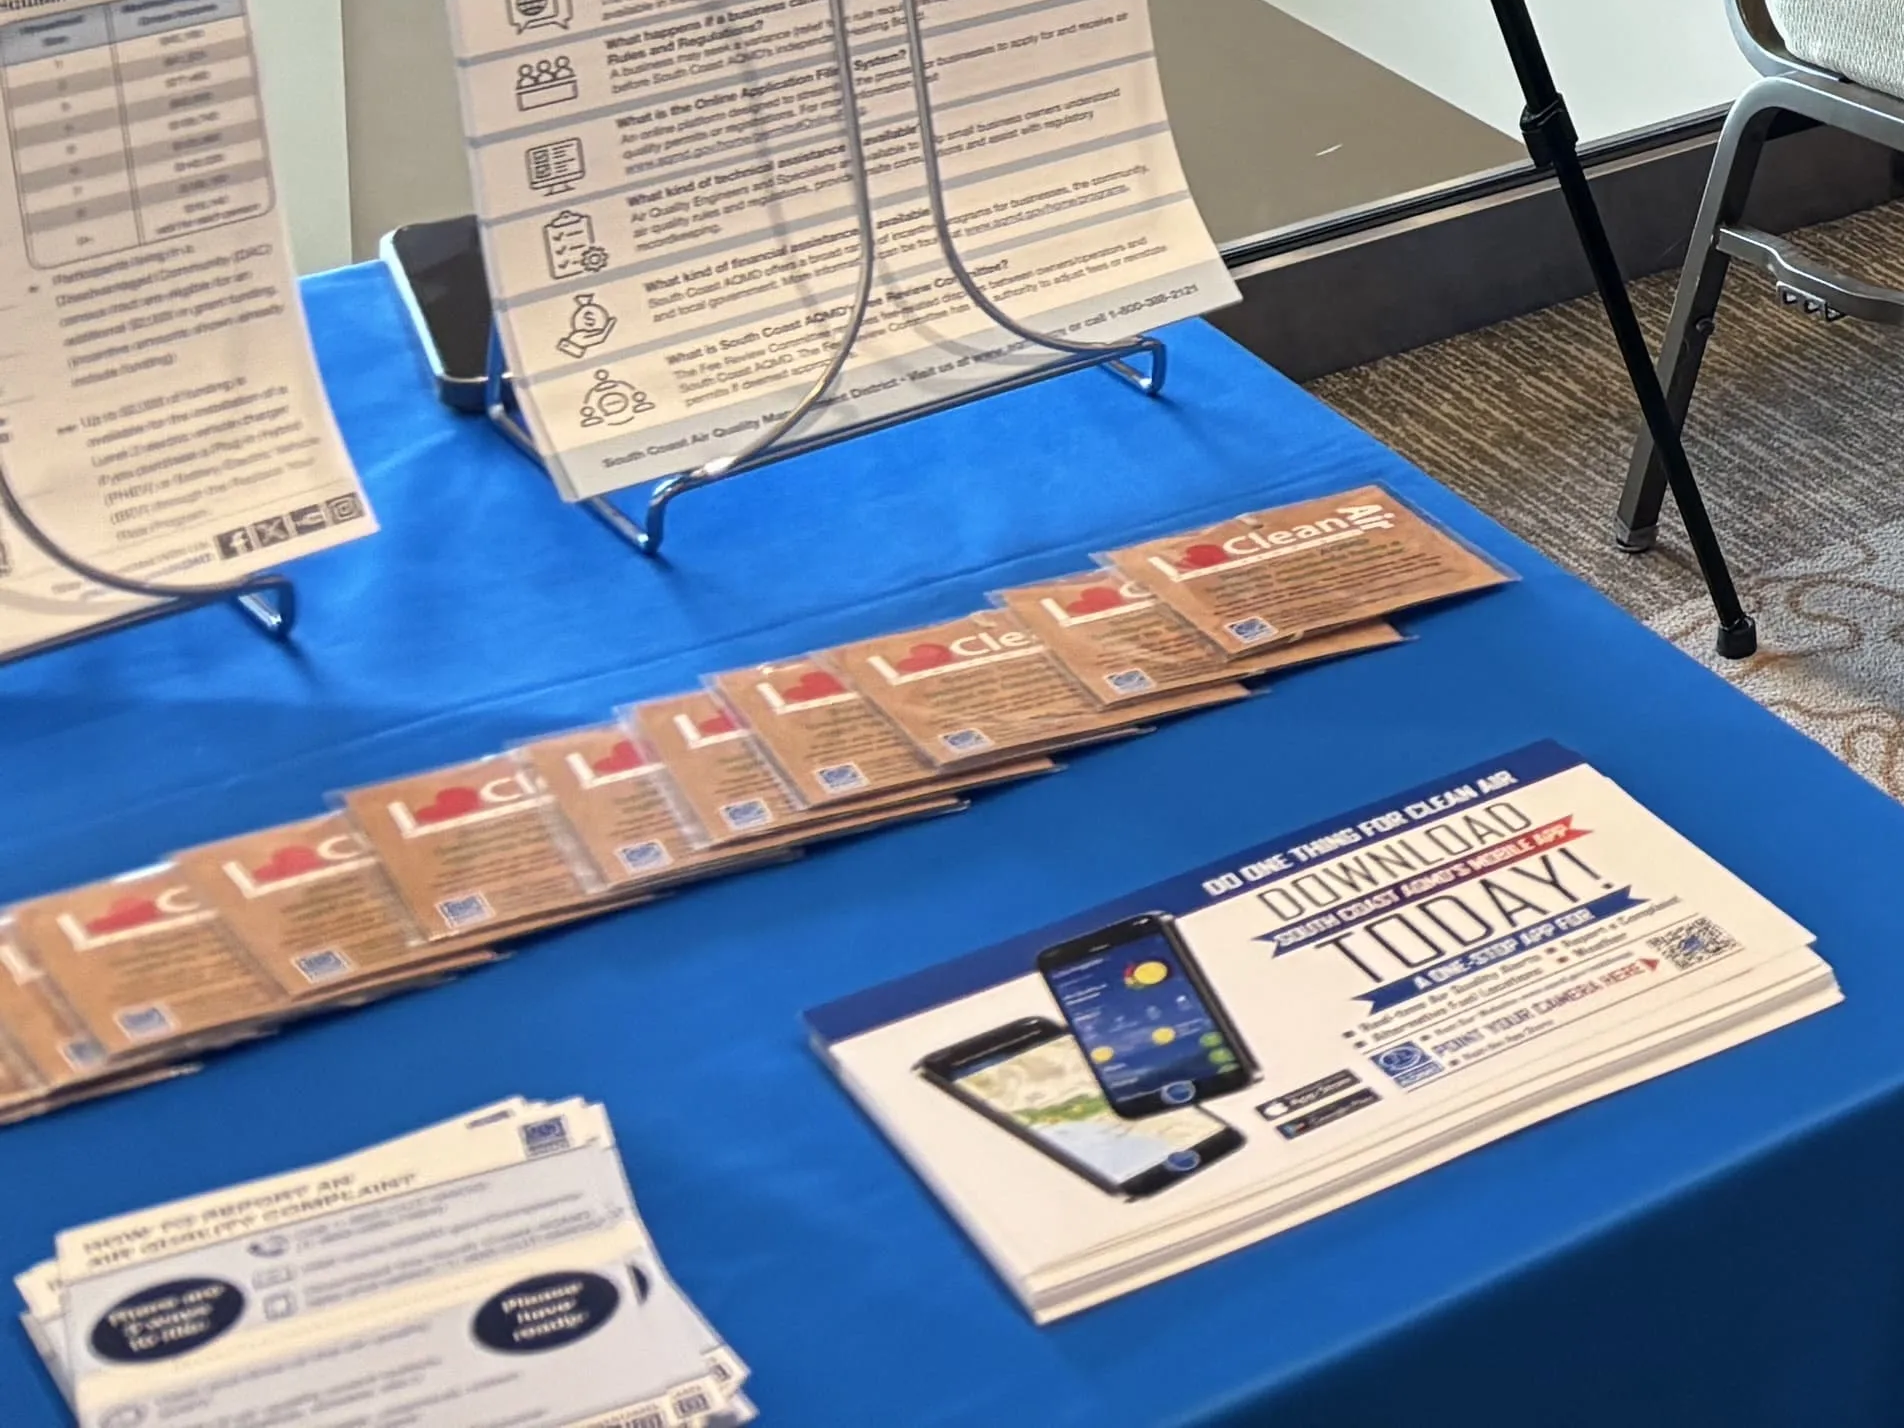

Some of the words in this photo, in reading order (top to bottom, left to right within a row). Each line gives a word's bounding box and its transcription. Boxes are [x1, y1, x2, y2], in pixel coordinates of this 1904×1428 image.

[1222, 513, 1344, 558] Clean
[1336, 503, 1396, 532] Air
[1201, 871, 1241, 897] DO
[1238, 854, 1295, 883] ONE
[1287, 826, 1363, 864] THING
[1356, 808, 1410, 839] FOR
[1402, 782, 1480, 822] CLEAN
[1474, 769, 1520, 799] AIR
[1255, 800, 1533, 924] DOWNLOAD
[1313, 848, 1617, 985] TODAY!
